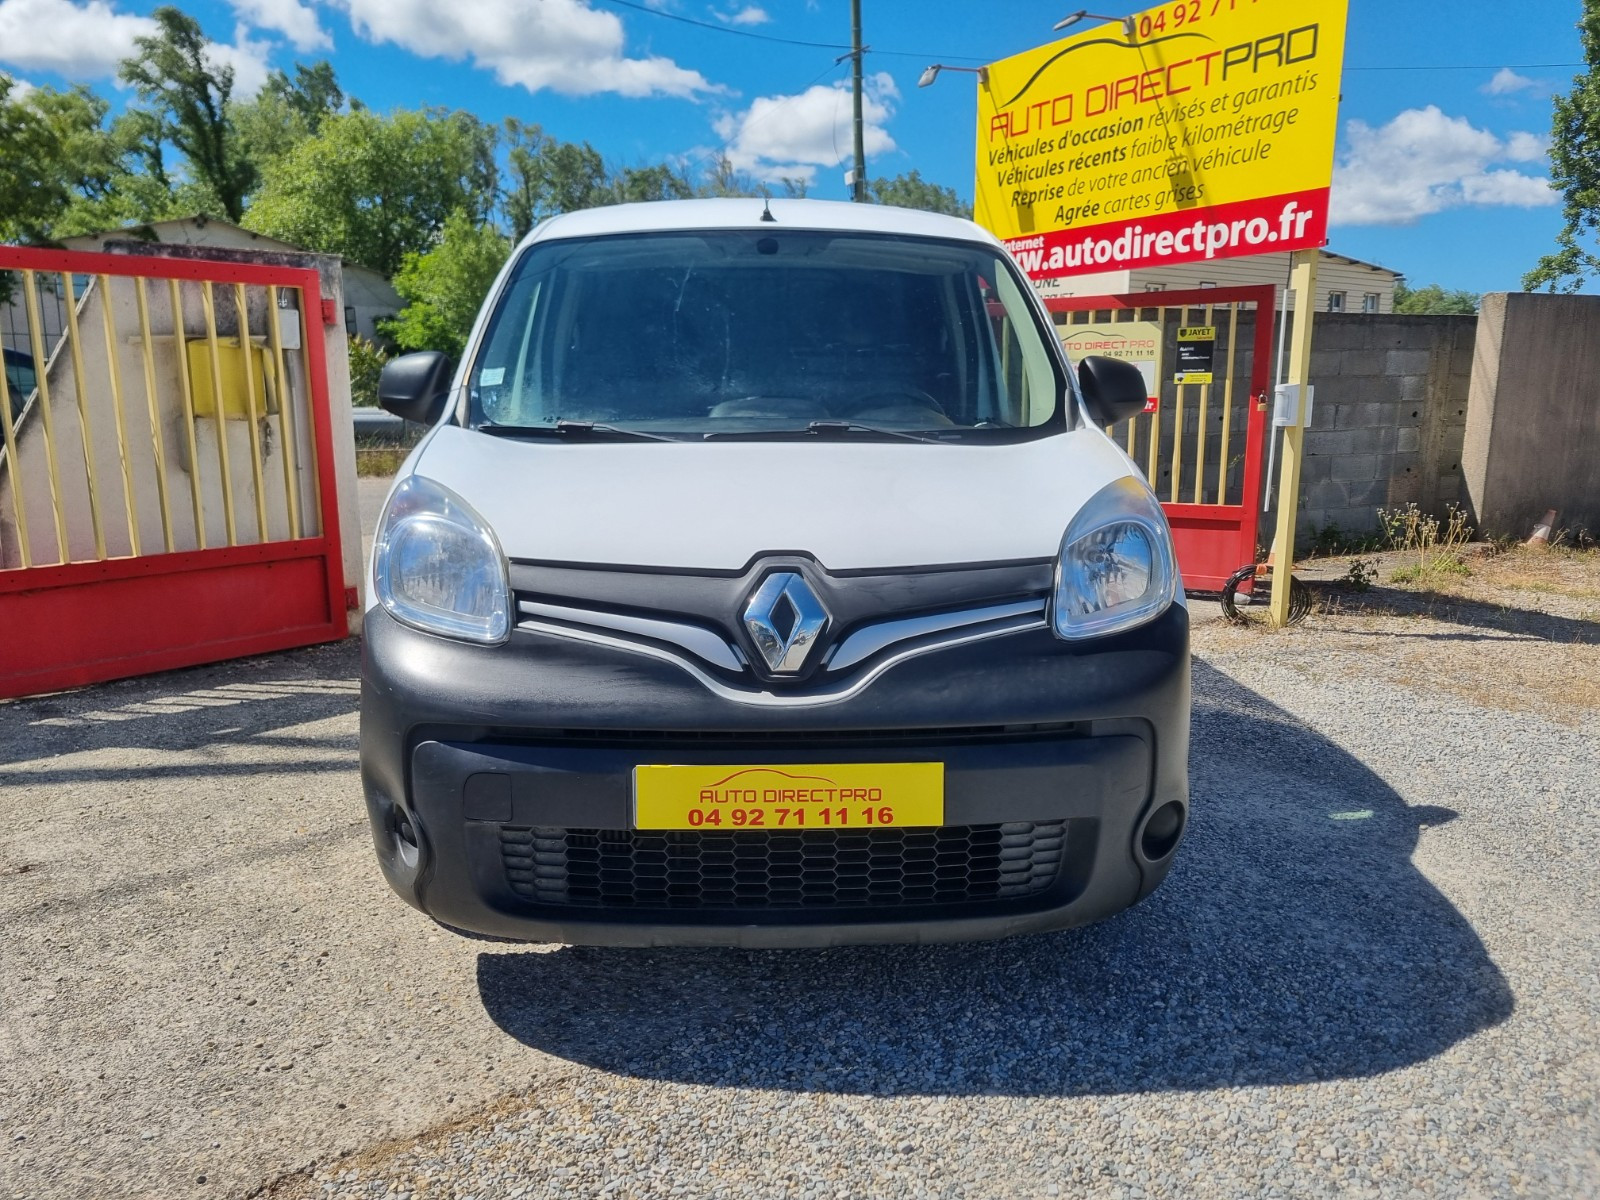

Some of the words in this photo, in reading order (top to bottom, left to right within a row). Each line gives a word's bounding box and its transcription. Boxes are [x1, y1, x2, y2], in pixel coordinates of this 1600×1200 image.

[1140, 10, 1166, 38] 04
[1173, 0, 1200, 28] 92
[988, 137, 1055, 167] Véhicules
[1058, 116, 1144, 150] d'occasion
[1147, 98, 1206, 129] révisés
[1210, 93, 1230, 114] et
[1232, 69, 1318, 115] garantis
[990, 94, 1073, 143] AUTO
[997, 156, 1065, 188] Véhicules
[1068, 145, 1127, 172] récents
[1130, 134, 1178, 160] faible
[1181, 107, 1299, 148] kilométrage
[1011, 184, 1064, 208] Reprise
[1067, 178, 1085, 197] de
[1089, 172, 1128, 193] votre
[1131, 158, 1187, 185] ancien
[1193, 139, 1271, 173] véhicule
[1054, 200, 1100, 226] Agrée
[1103, 191, 1150, 215] cartes
[1154, 182, 1204, 211] grises
[1013, 201, 1313, 273] w.autodirectpro.fr
[1084, 340, 1128, 351] DIRECT
[1129, 340, 1155, 349] PRO
[1188, 328, 1211, 336] JAYET
[688, 809, 722, 827] 04
[731, 809, 765, 826] 92
[774, 808, 806, 826] 71
[818, 807, 849, 825] 11
[861, 807, 894, 825] 16
[699, 789, 757, 804] AUTO
